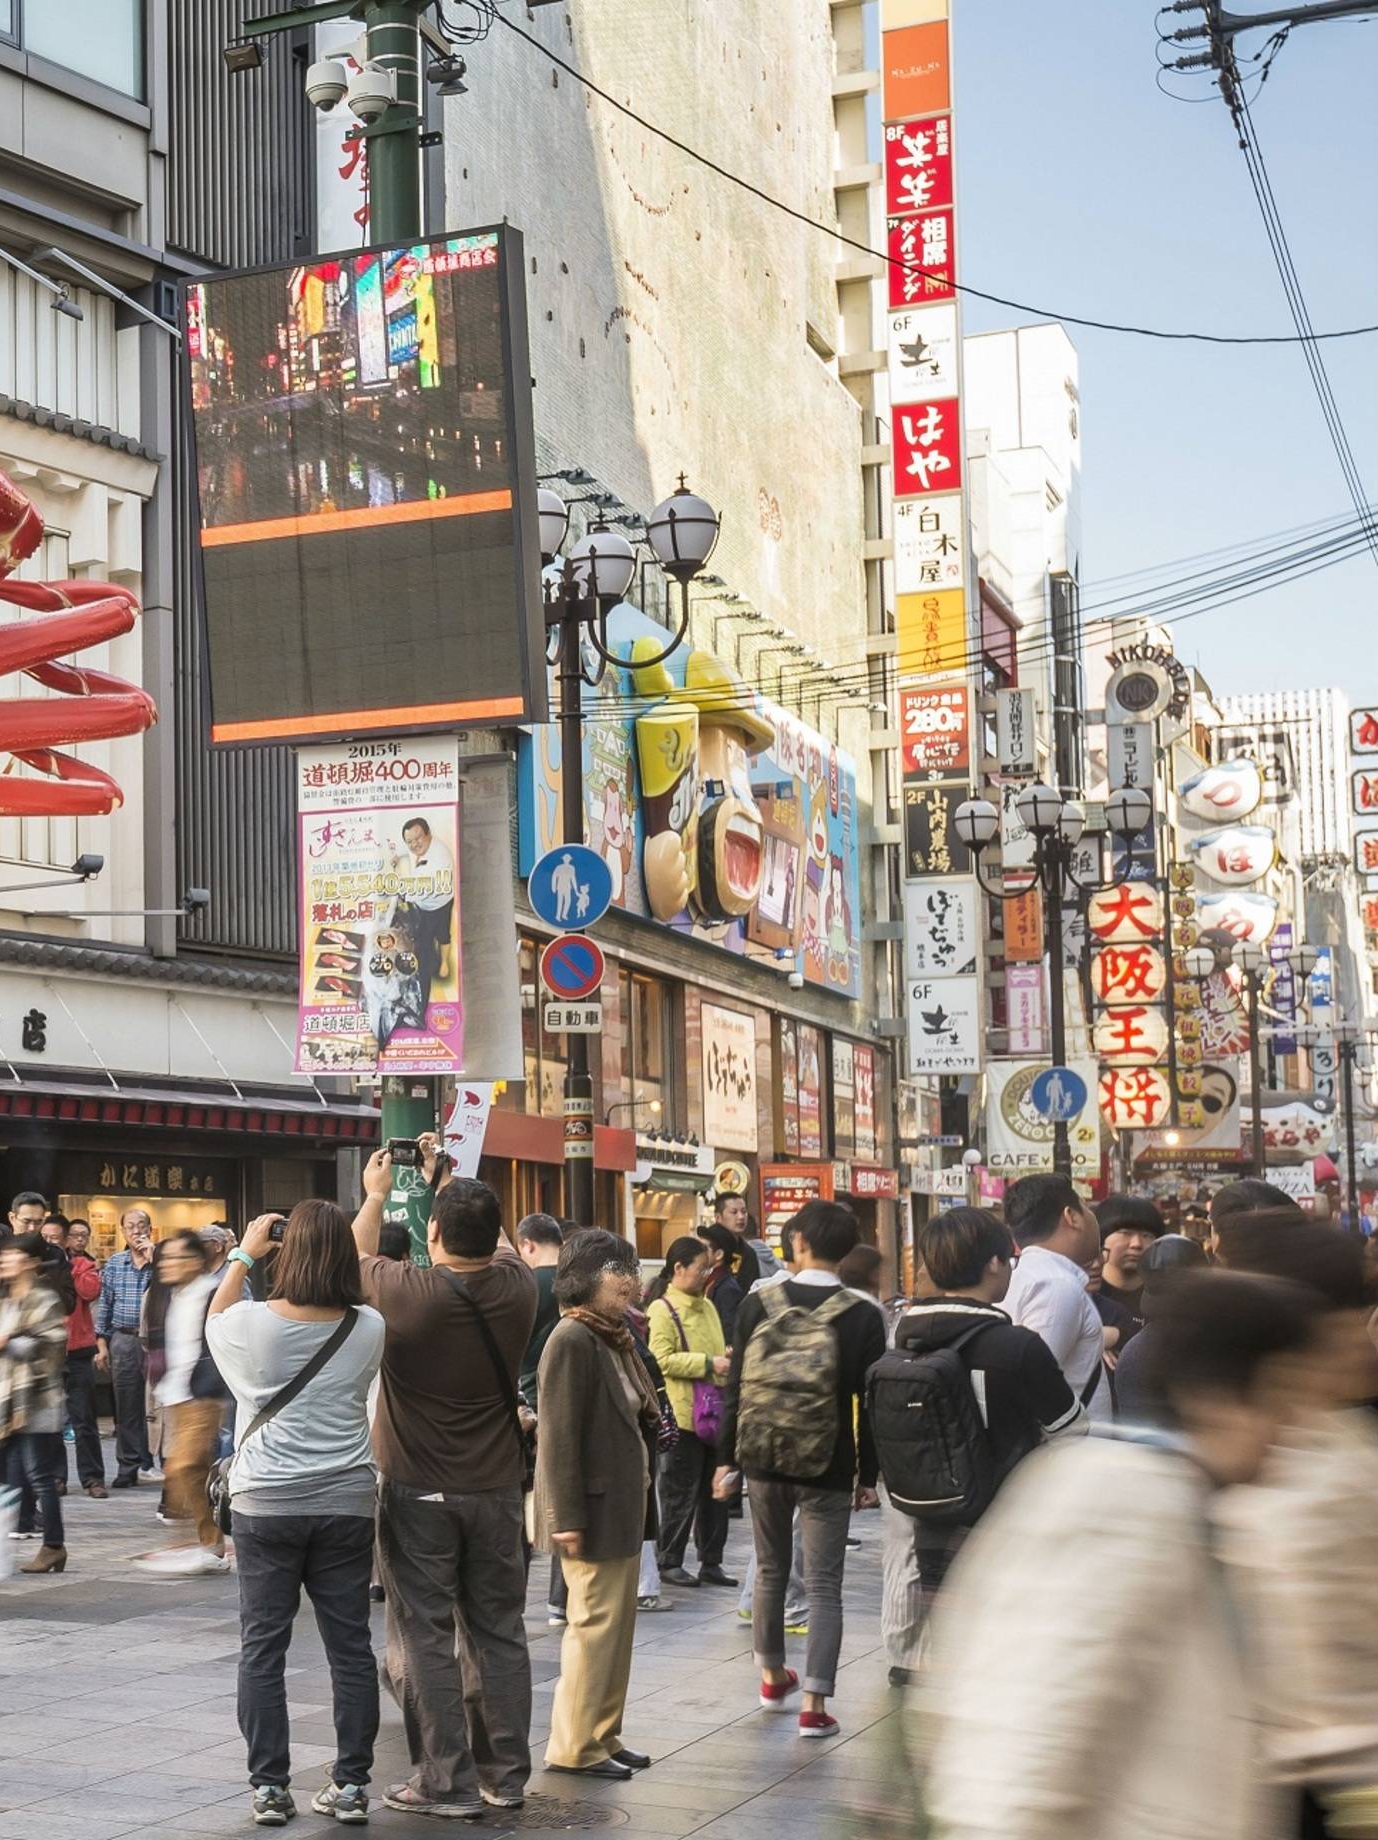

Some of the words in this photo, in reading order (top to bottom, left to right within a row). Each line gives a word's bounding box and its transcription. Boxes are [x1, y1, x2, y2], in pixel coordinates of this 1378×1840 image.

[900, 219, 922, 301] ダイニング
[893, 316, 912, 331] 6F
[898, 504, 913, 516] 4F
[915, 506, 958, 583] 白木屋
[347, 742, 402, 760] 2015年
[302, 758, 454, 788] 道頓堀400周年
[907, 791, 926, 805] 2F
[913, 984, 932, 1000] 6F
[1090, 883, 1169, 1126] 大阪王将
[547, 1010, 599, 1026] 自動車
[990, 1154, 1038, 1166] CAFE
